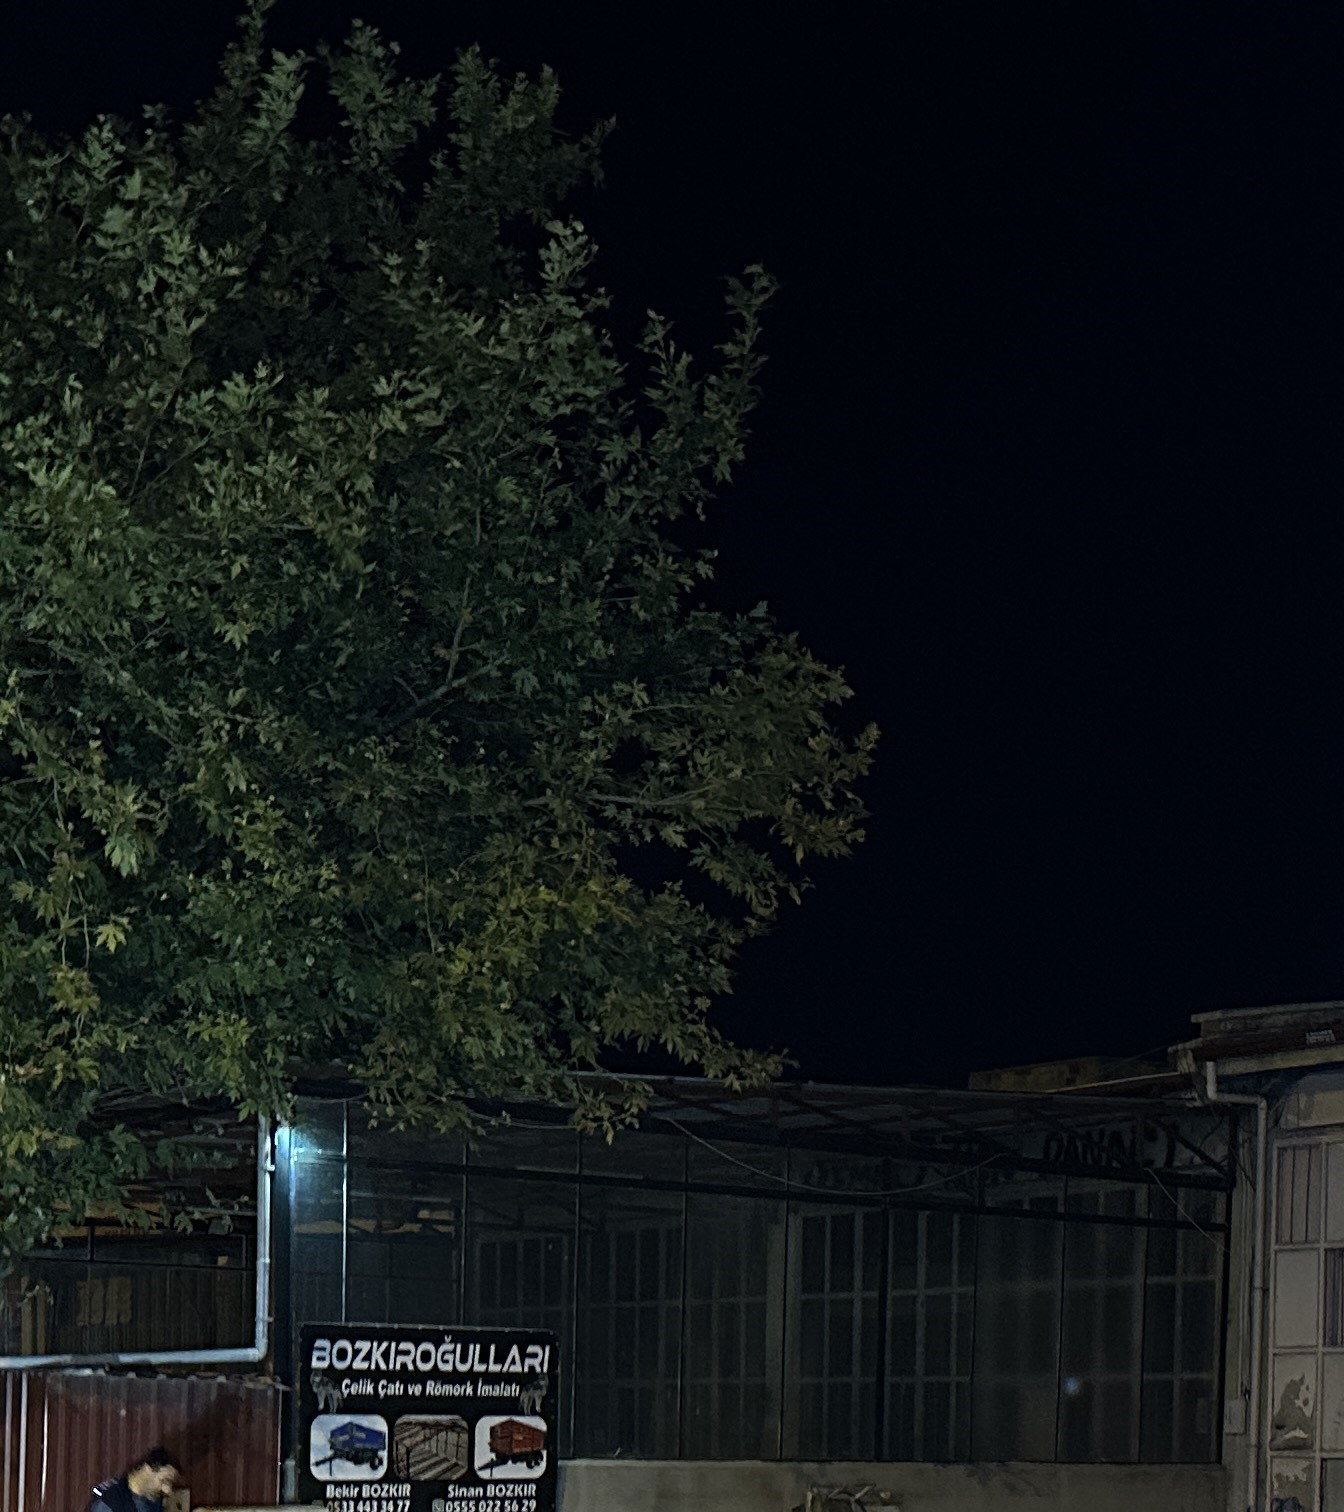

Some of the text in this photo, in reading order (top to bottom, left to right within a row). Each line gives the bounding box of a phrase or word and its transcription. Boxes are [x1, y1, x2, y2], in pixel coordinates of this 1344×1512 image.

[311, 1335, 550, 1374] BOZKIROĞULLARI
[341, 1377, 520, 1400] Çelik Çatı ve Römork İmalatı
[326, 1483, 411, 1499] Bekir BOZKIR
[447, 1483, 536, 1498] Sinan BOZKIR
[504, 1499, 519, 1512] 56
[521, 1499, 536, 1512] 29
